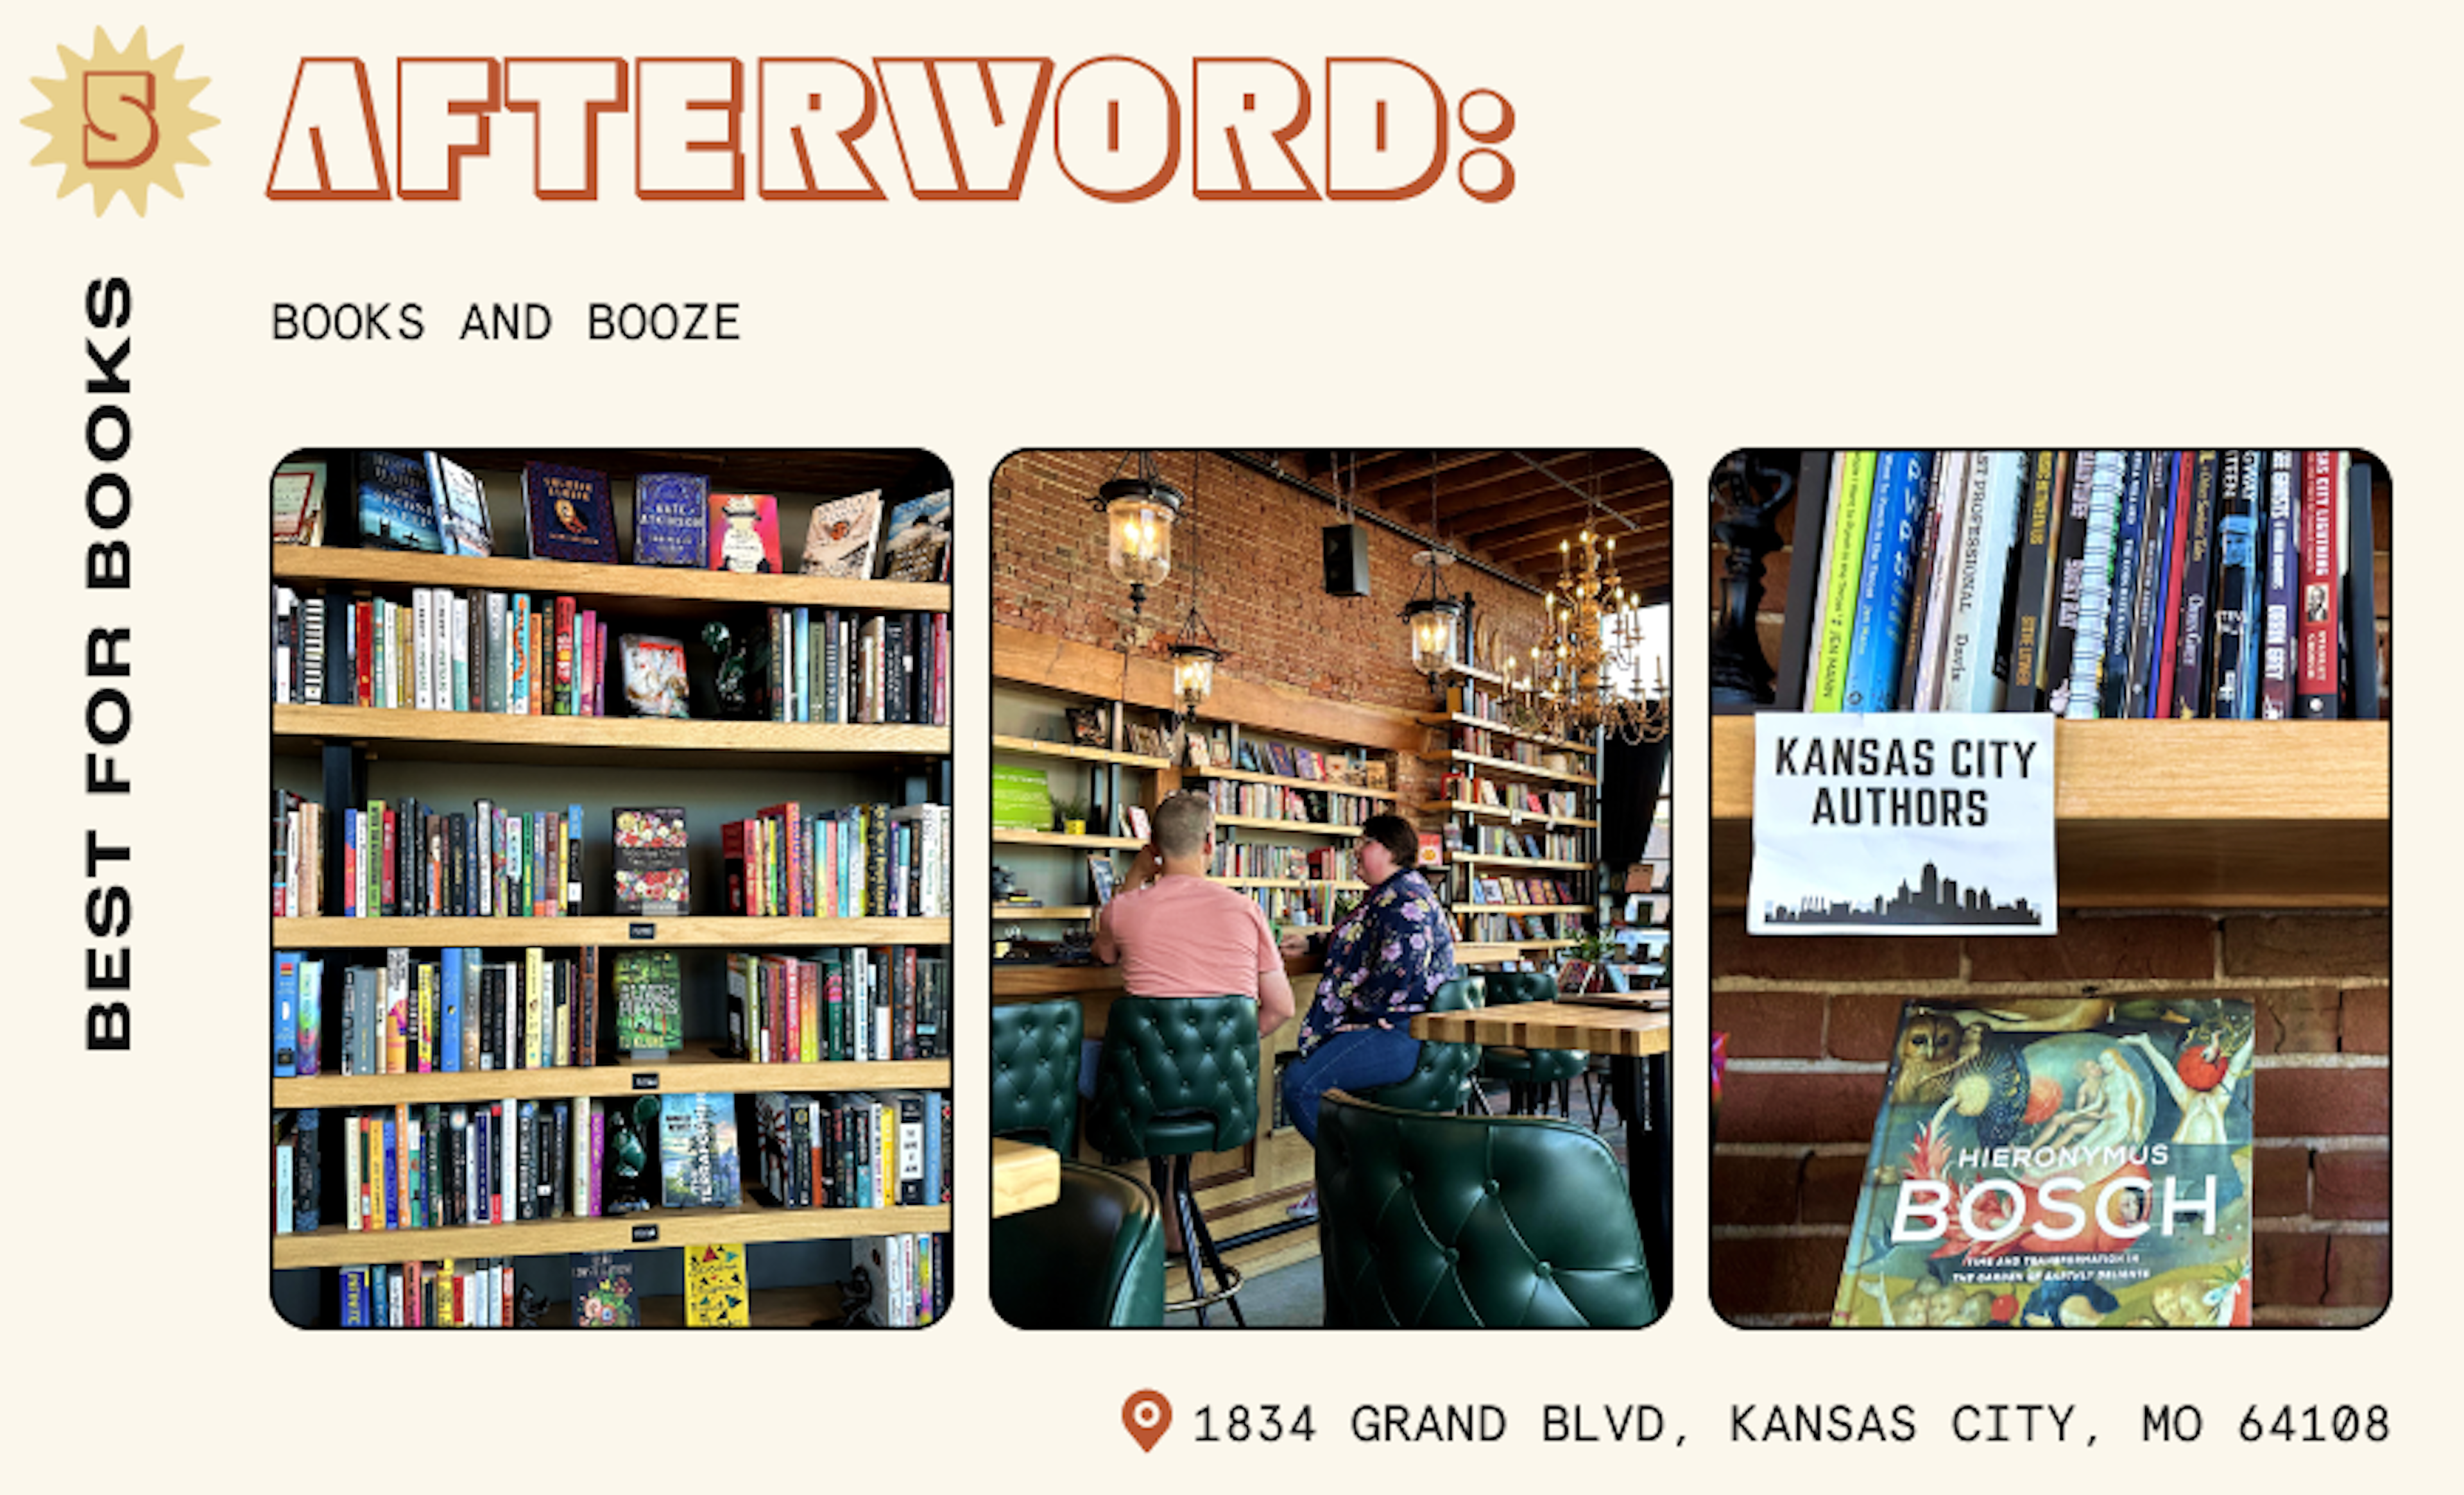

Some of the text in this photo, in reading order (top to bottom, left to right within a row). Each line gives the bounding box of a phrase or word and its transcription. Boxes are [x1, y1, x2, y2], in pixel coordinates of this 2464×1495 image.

[2270, 471, 2290, 518] GHOSTS
[2315, 476, 2330, 507] CITY
[1960, 481, 1986, 612] PROFESSIONAL
[2314, 508, 2330, 577] LIGHTNING
[1951, 633, 1969, 681] Davis
[1776, 737, 2037, 778] KANSAS CITY
[1812, 787, 1988, 826] AUTHORS
[1958, 1143, 2169, 1170] HIERONYMUS
[1891, 1174, 2218, 1243] BOSCH
[1953, 1272, 1976, 1283] THE
[1976, 1272, 2024, 1283] GARDEN
[2026, 1270, 2043, 1282] OF
[1967, 1254, 2140, 1267] TIME AND TRANSFORMATION IN
